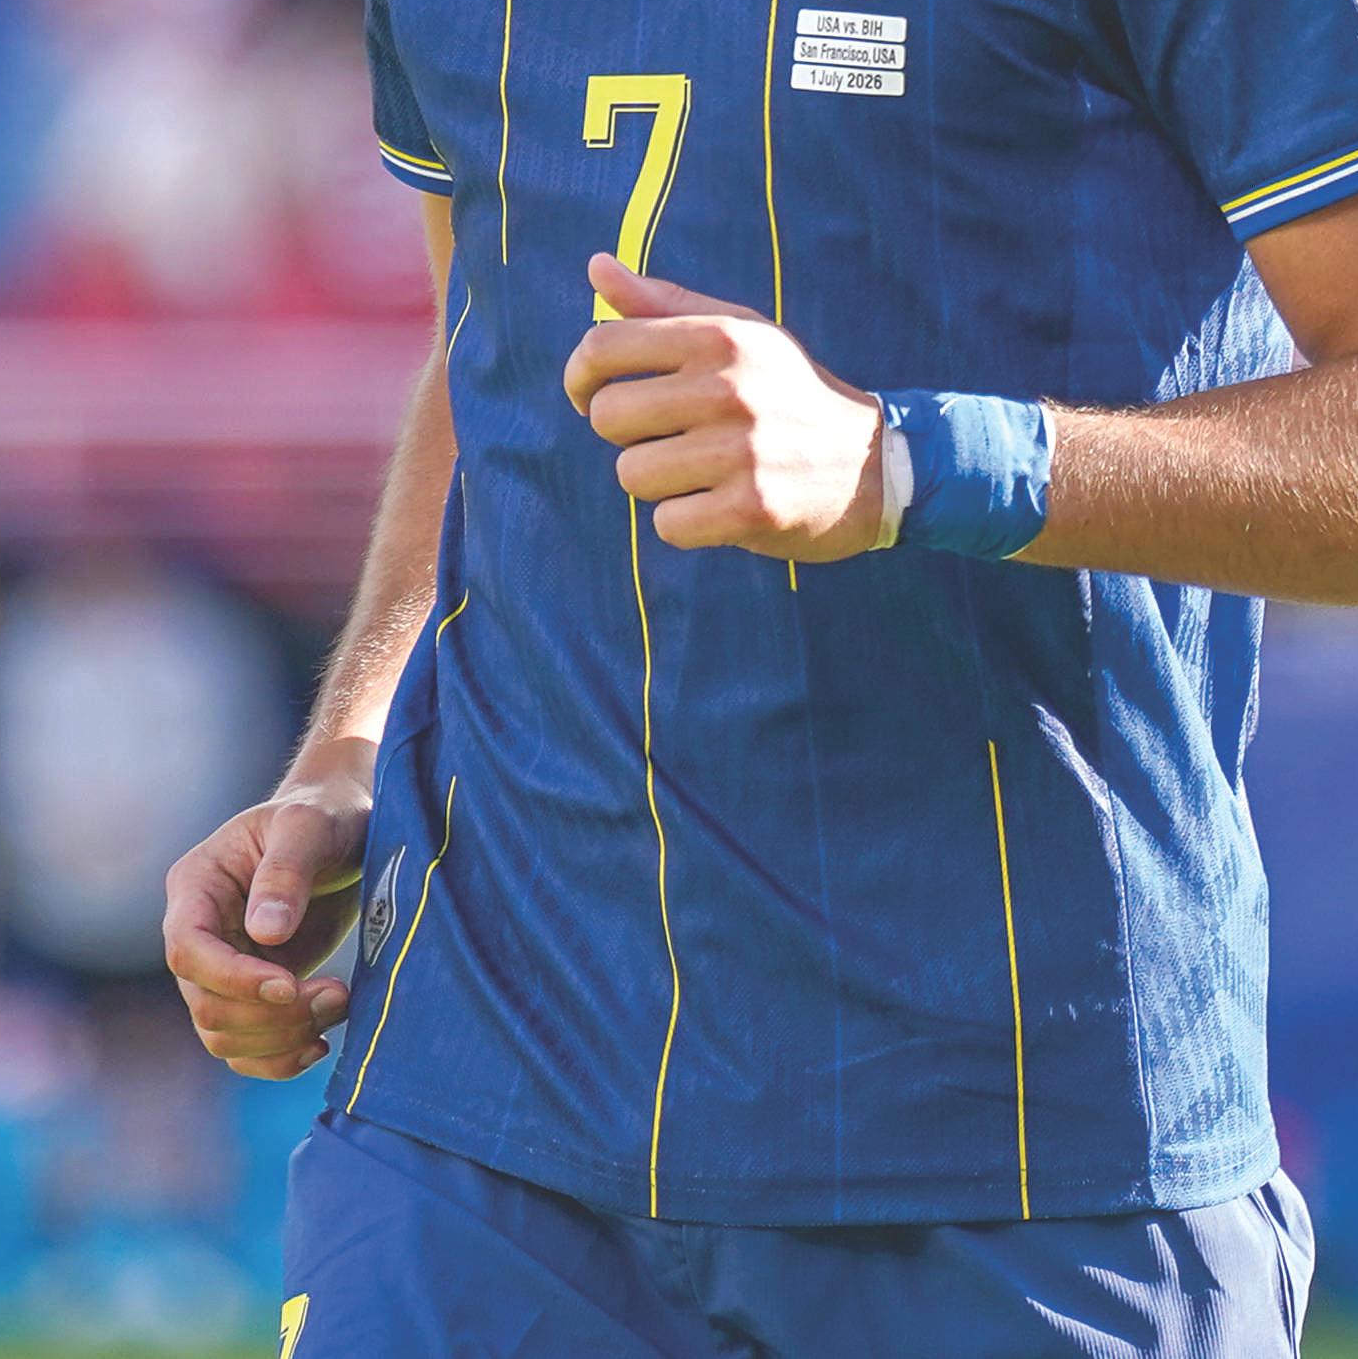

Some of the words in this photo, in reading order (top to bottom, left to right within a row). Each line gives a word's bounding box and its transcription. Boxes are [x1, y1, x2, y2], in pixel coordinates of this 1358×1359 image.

[817, 16, 840, 33] USA
[843, 22, 859, 34] vs.
[862, 20, 883, 36] BIH
[800, 42, 818, 58] San
[872, 48, 897, 65] USA
[811, 69, 816, 85] 1
[818, 70, 843, 93] July
[847, 73, 883, 90] 2026
[583, 74, 691, 325] 7
